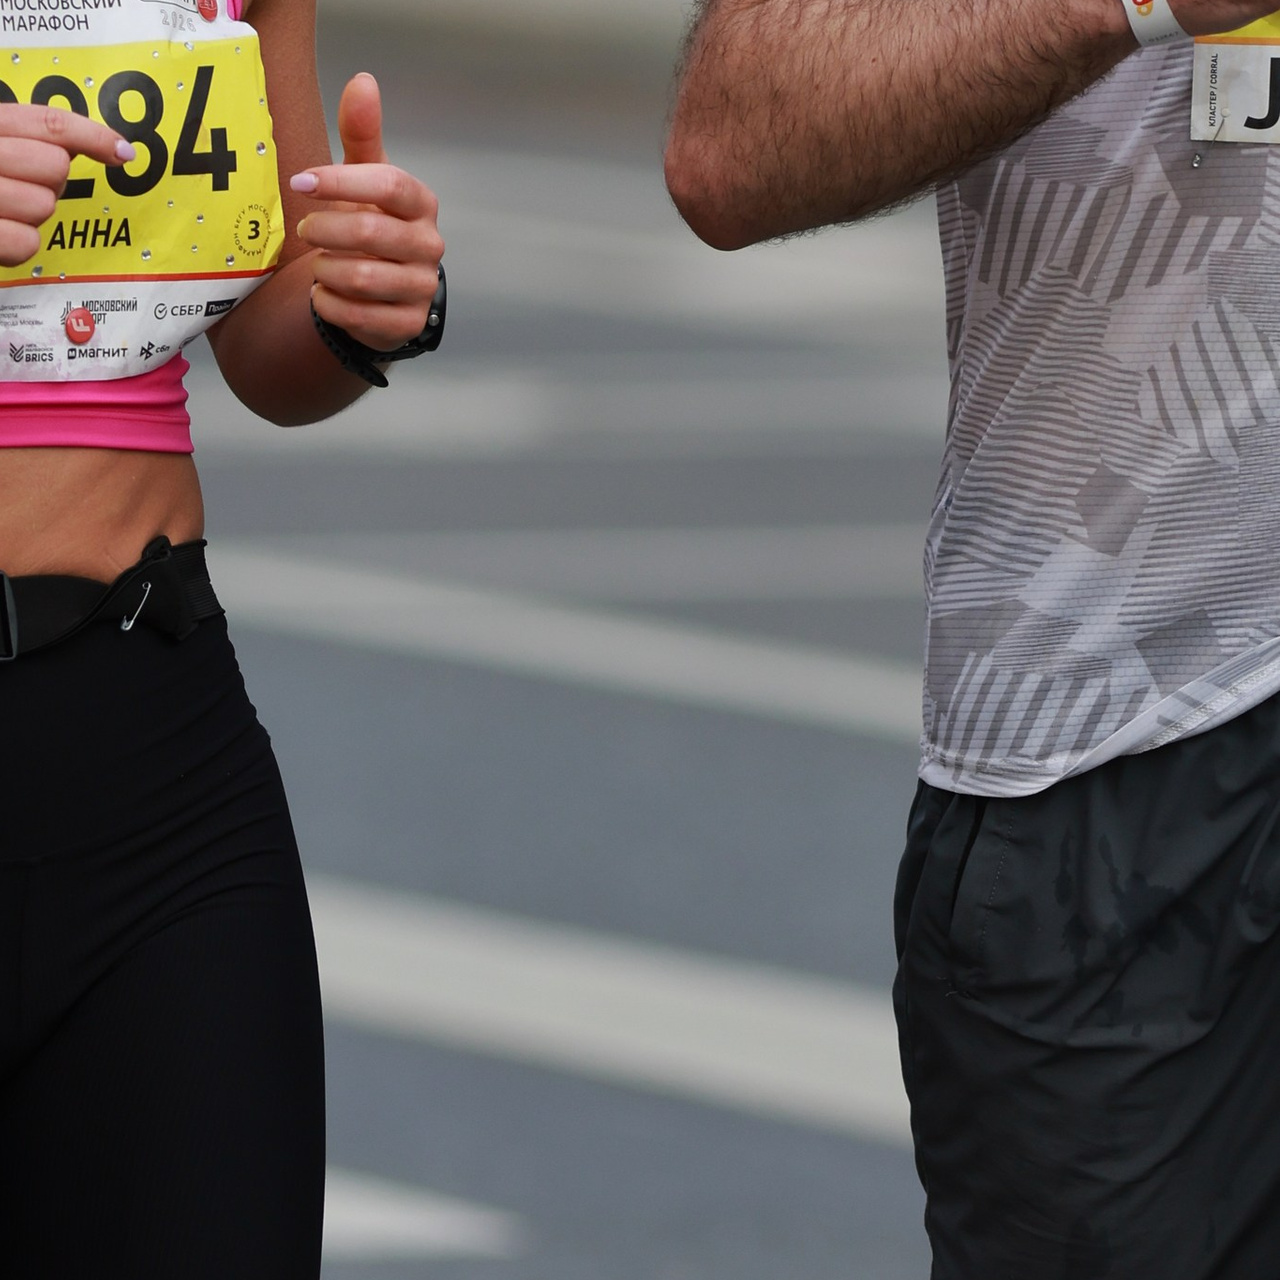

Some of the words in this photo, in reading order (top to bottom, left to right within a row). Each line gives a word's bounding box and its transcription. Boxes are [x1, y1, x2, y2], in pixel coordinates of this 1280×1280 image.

[2, 14, 89, 31] МАРАФОН
[1210, 53, 1218, 85] CORRAL
[1243, 57, 1280, 130] J
[1209, 91, 1218, 127] КЛАСТЕР
[46, 217, 132, 251] АННА
[247, 219, 260, 240] 3
[81, 297, 138, 312] МОСКОВСКИЙ
[170, 304, 203, 316] СБЕР
[25, 353, 54, 362] BRICS
